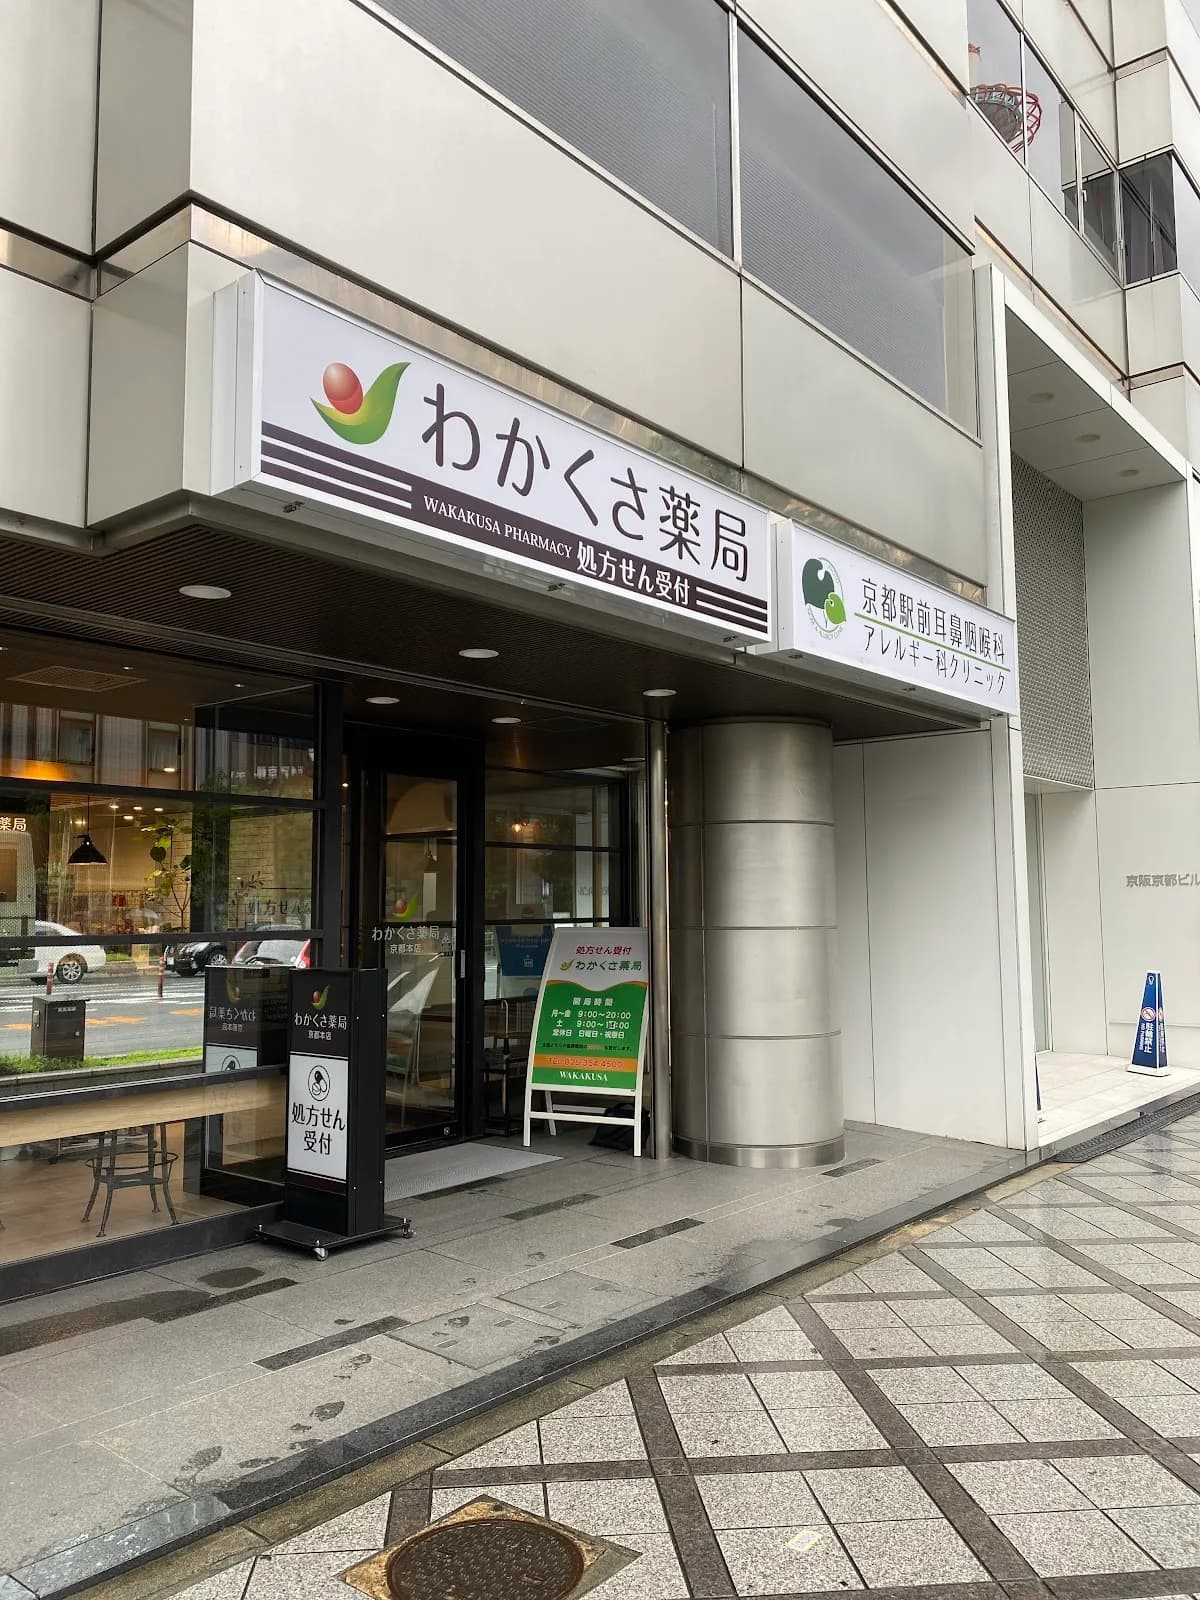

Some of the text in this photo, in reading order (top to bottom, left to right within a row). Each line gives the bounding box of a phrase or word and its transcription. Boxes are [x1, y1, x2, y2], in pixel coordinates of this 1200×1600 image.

[422, 383, 748, 582] わかくさ薬局
[424, 496, 572, 558] WAKAKUSA PHARMACY
[577, 541, 690, 605] 処方せん受付
[861, 577, 1005, 664] 京都駅前耳鼻咽喉科
[864, 624, 1005, 694] アレルギー科クリニック
[371, 925, 440, 941] わかくさ薬局
[575, 945, 632, 955] 処方せん受付
[575, 960, 642, 971] わかくさ薬局
[294, 1012, 347, 1030] わかくさ薬局
[556, 1019, 564, 1027] 土
[560, 1071, 609, 1082] WAKAKUSA
[291, 1101, 346, 1131] 処方せん
[303, 1130, 333, 1156] 受付
